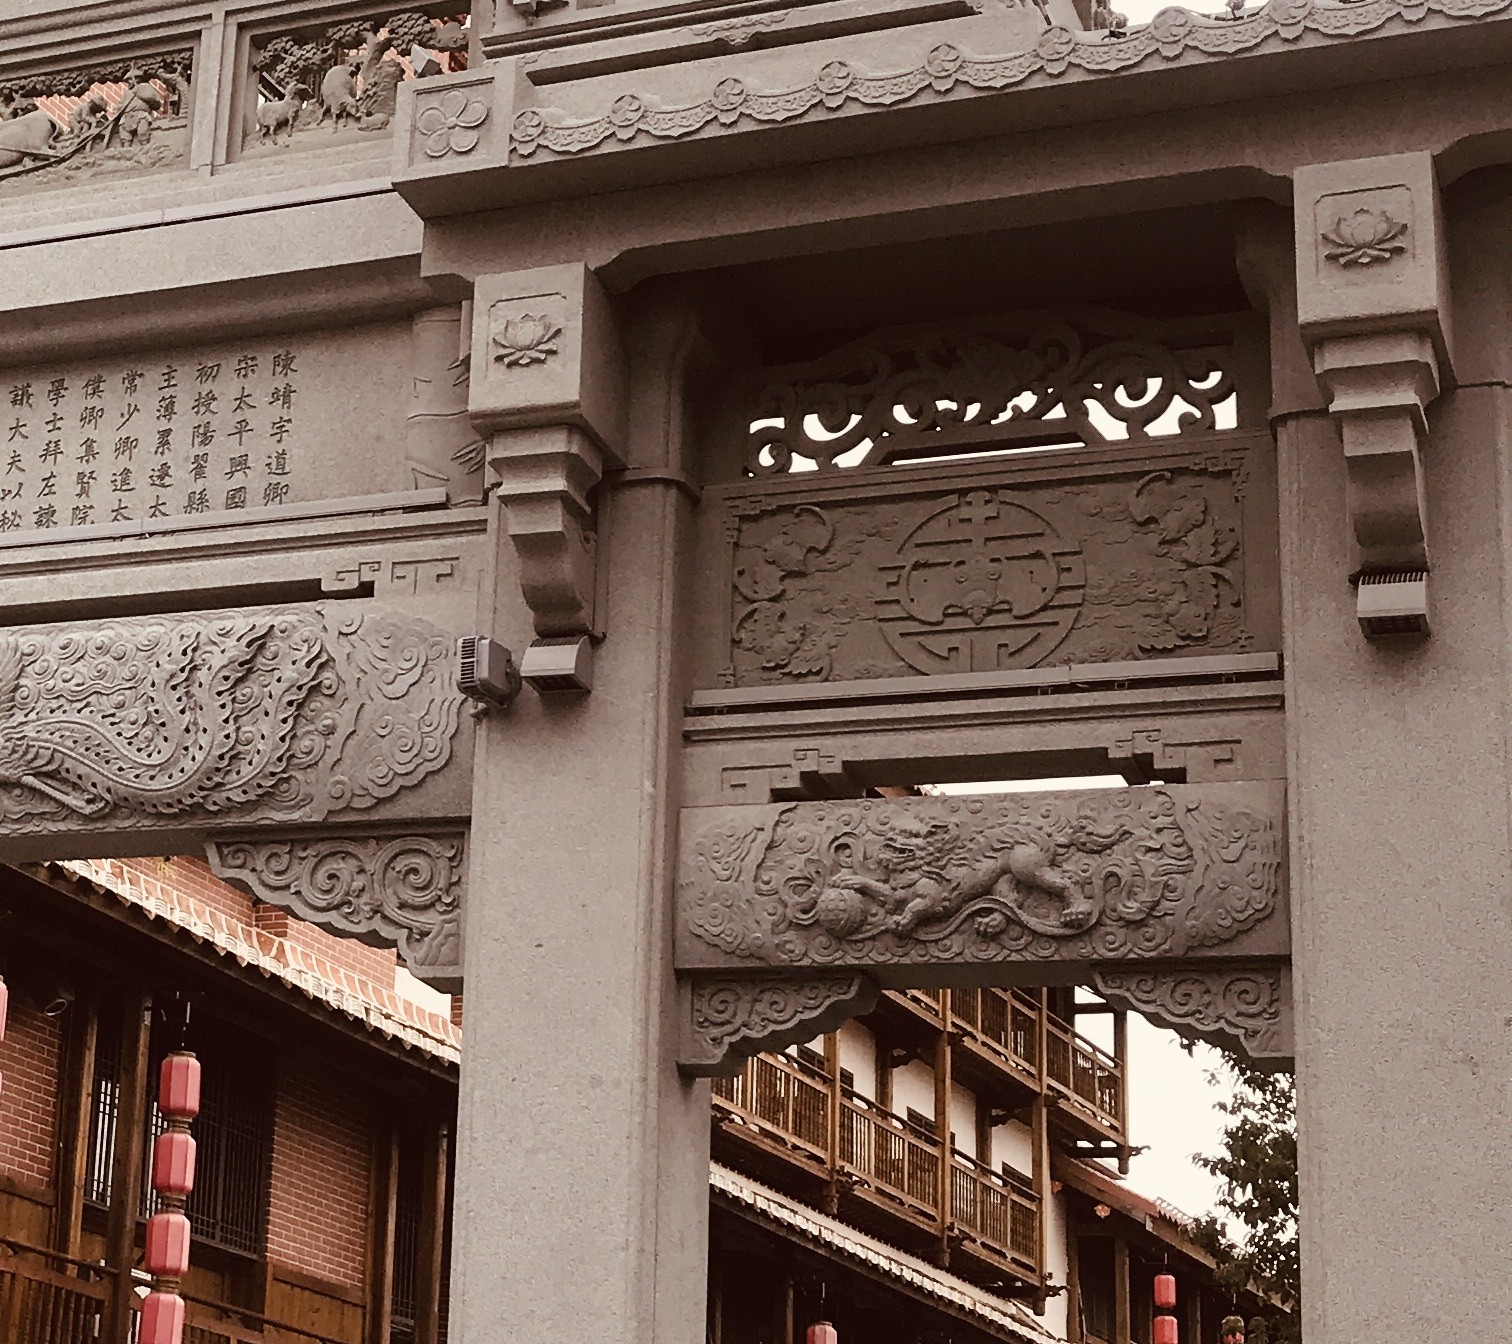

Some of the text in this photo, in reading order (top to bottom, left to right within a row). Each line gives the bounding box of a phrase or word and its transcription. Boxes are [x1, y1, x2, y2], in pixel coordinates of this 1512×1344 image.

[110, 369, 145, 522] 常少卿進太
